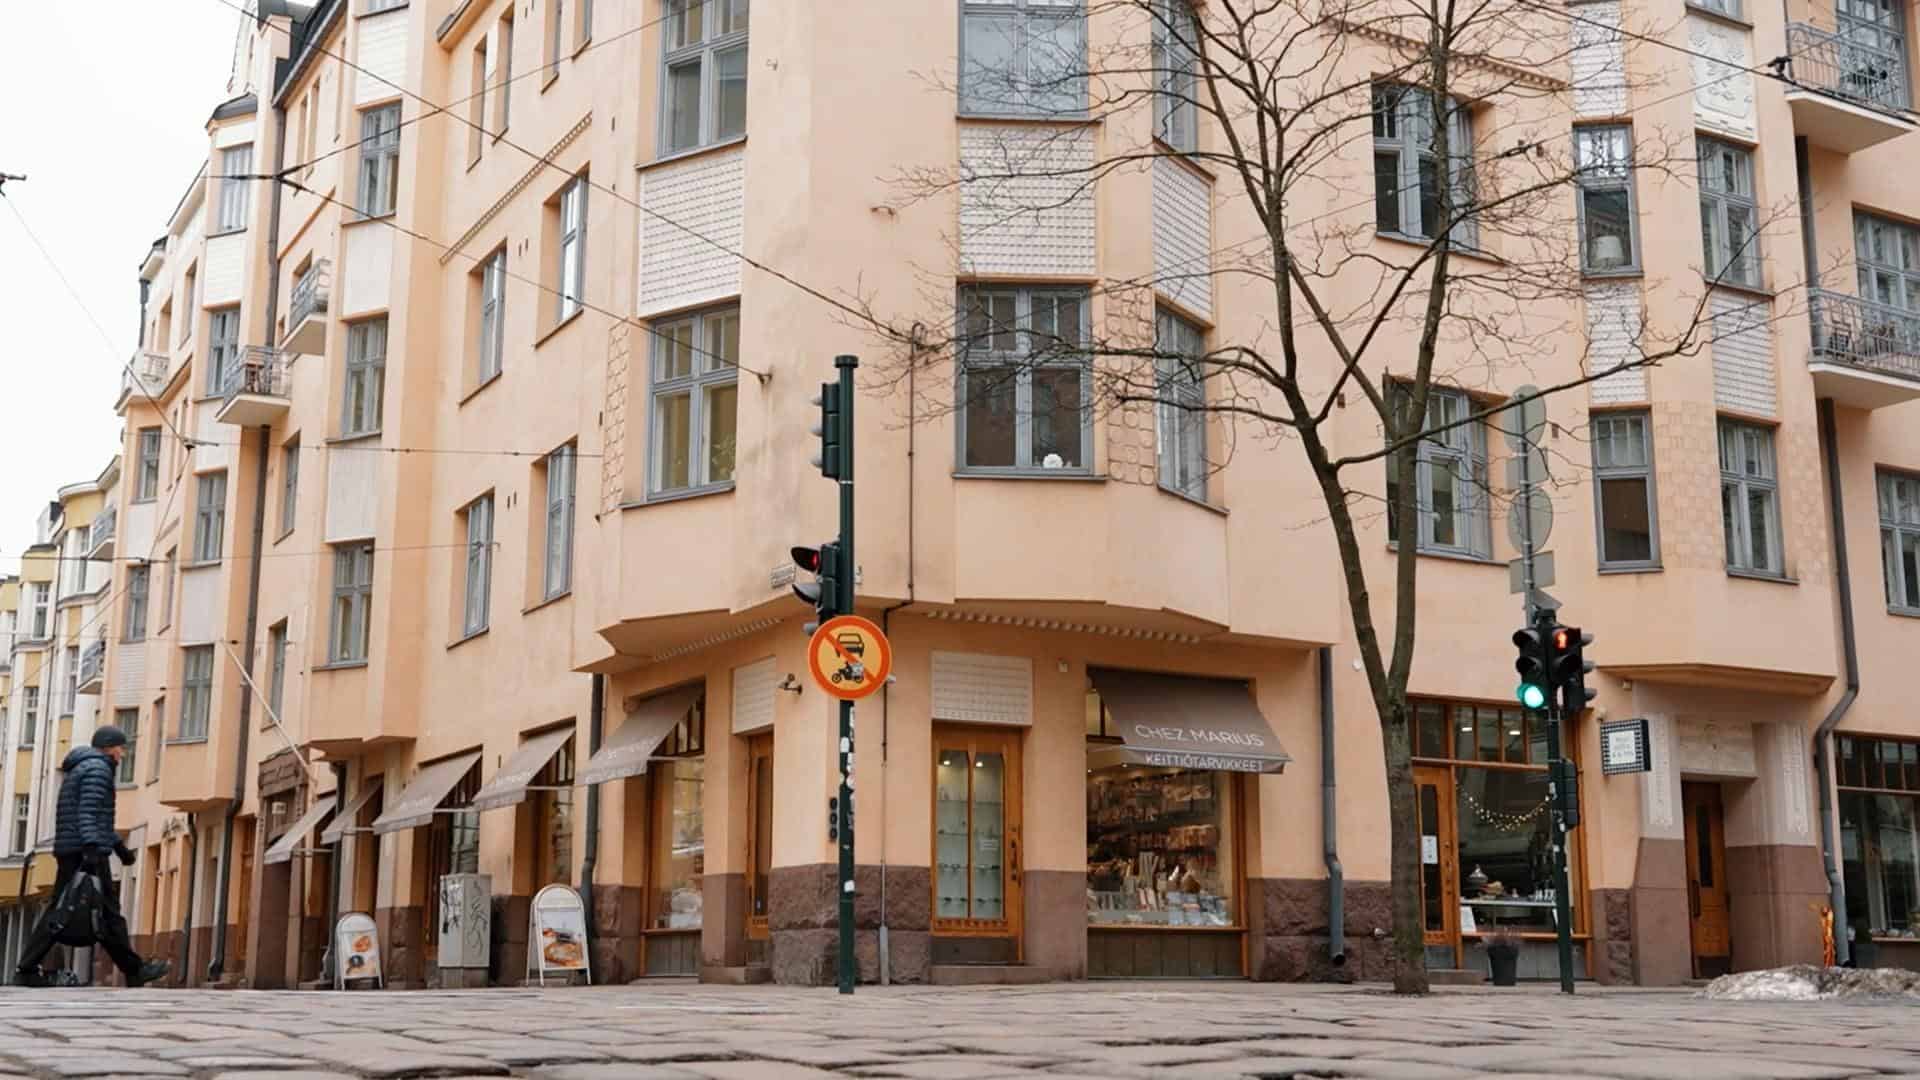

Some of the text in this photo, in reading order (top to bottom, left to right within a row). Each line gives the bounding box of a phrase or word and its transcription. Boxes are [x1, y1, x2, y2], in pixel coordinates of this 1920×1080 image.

[1135, 724, 1265, 747] CHEZ MARIUS
[1145, 752, 1264, 771] KEITTIÖTARVIKKEET
